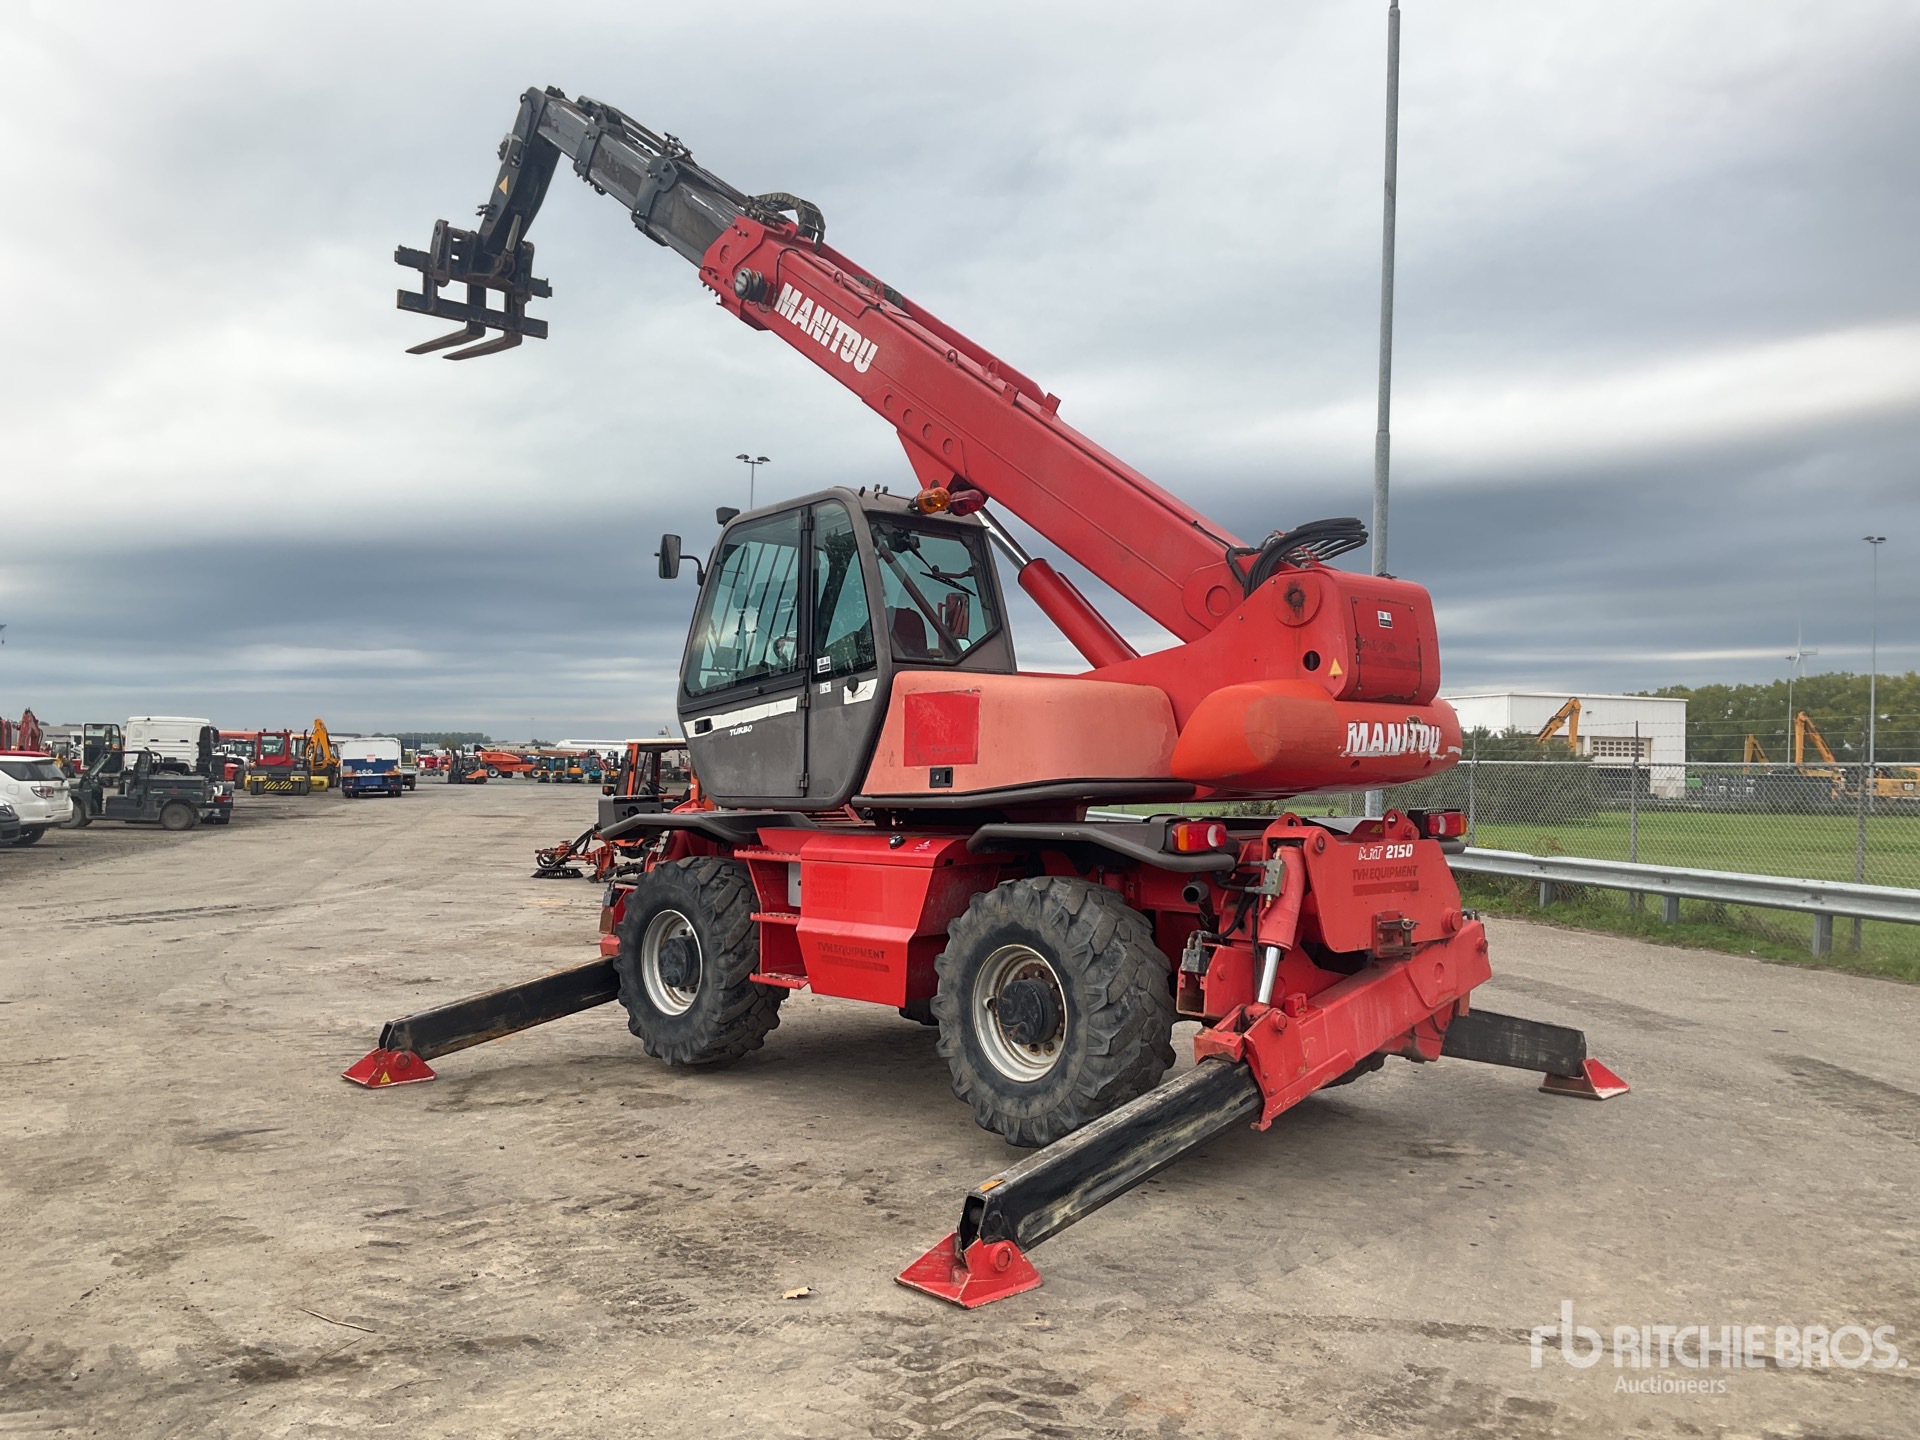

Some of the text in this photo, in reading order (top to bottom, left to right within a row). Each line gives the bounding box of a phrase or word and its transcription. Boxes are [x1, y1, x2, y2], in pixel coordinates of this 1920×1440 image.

[774, 282, 879, 373] MANITOU
[729, 724, 753, 737] TURBO
[1345, 722, 1441, 754] MANITOU
[1385, 843, 1414, 859] 2150
